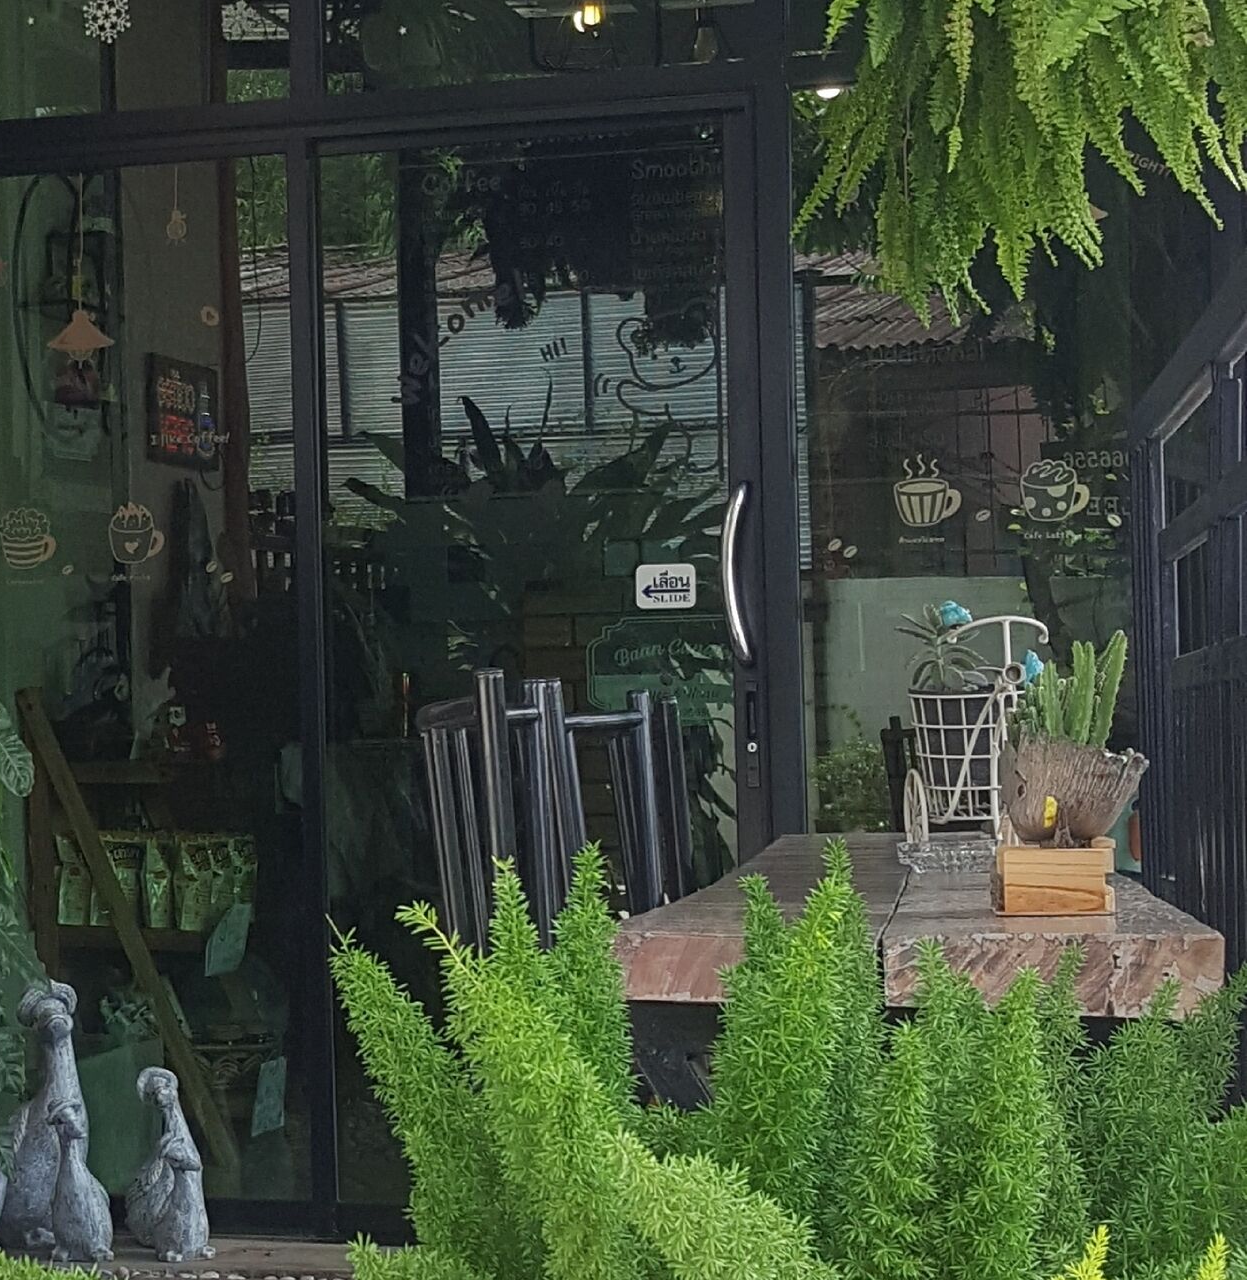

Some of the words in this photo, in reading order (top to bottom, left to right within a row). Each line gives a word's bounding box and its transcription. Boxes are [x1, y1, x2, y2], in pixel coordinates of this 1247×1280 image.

[653, 570, 691, 589] เลื่อน
[652, 593, 691, 603] SLIDE
[613, 643, 665, 667] Baan
